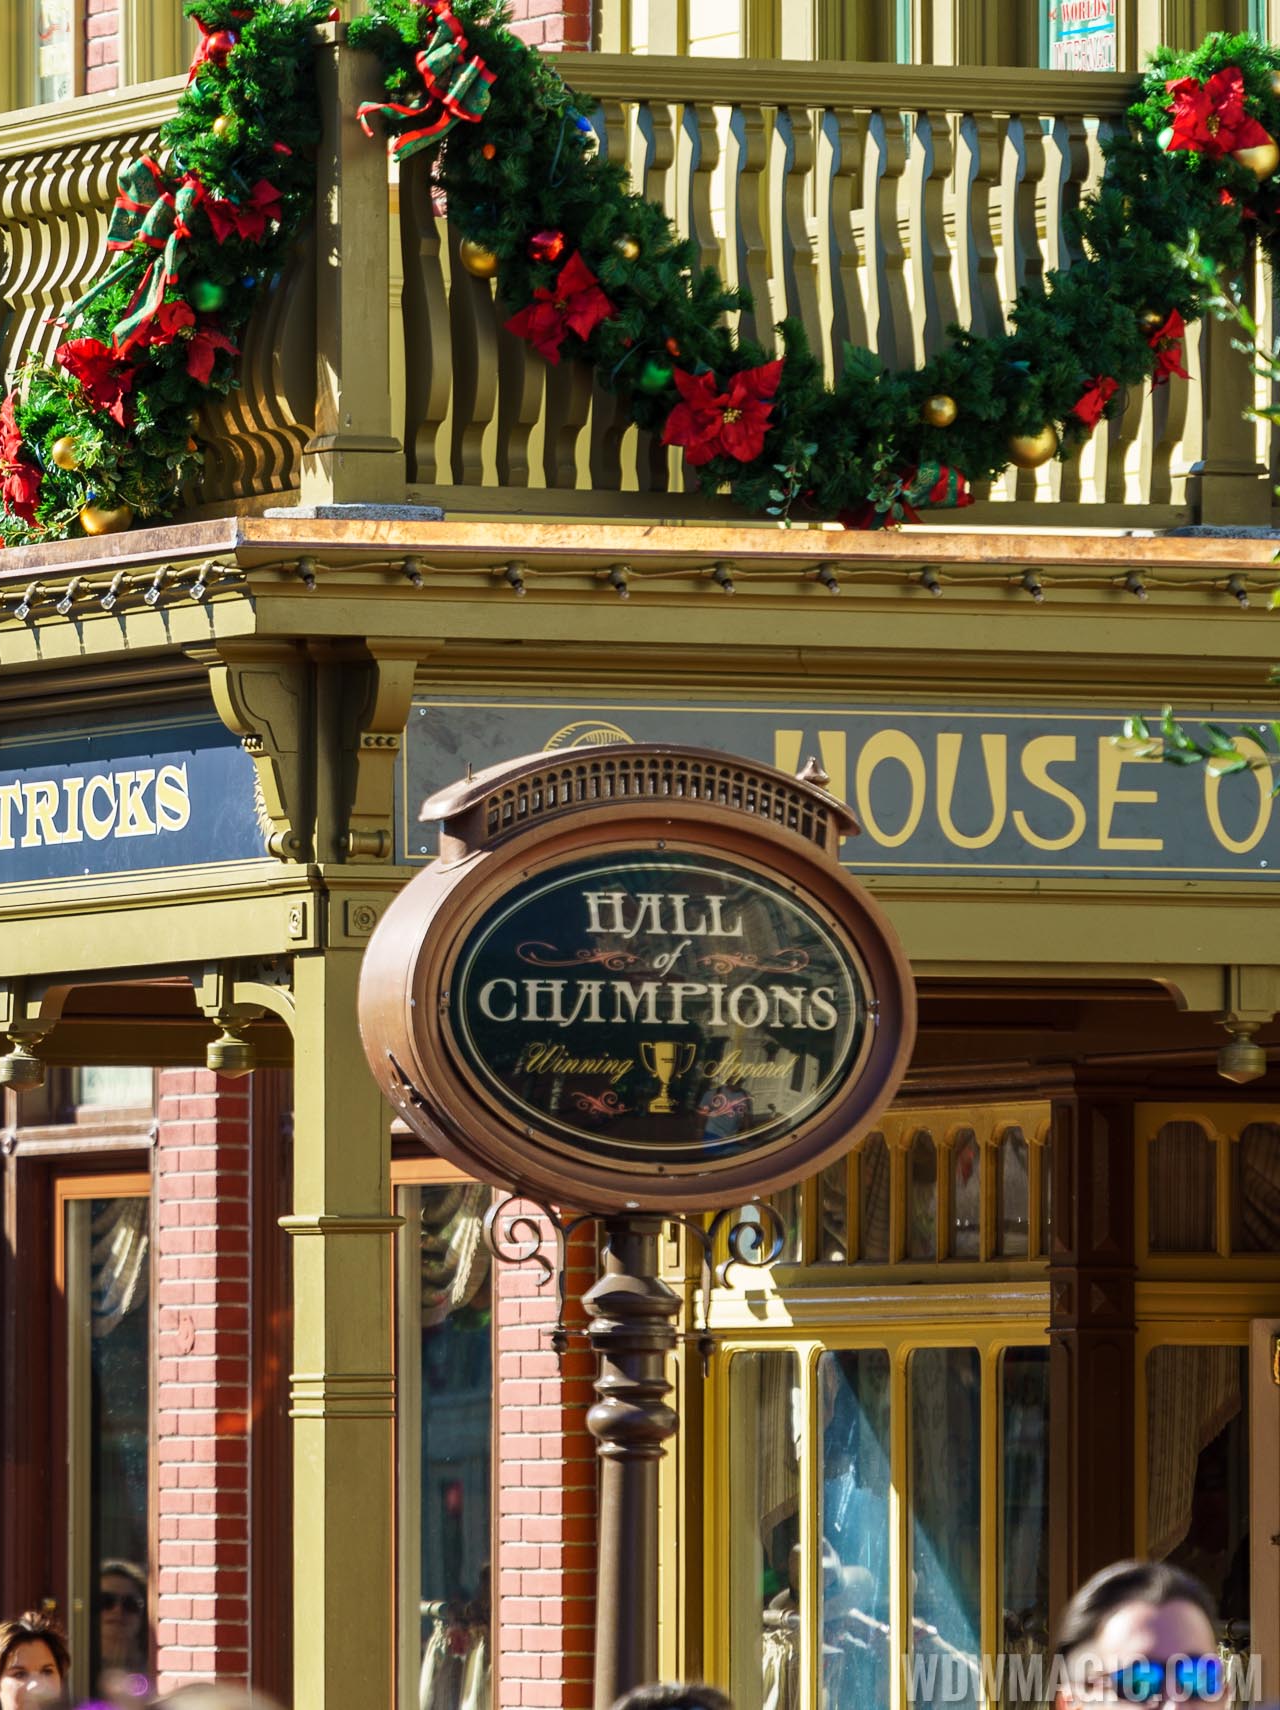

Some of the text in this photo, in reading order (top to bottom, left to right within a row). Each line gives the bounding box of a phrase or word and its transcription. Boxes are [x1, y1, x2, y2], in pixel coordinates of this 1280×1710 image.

[582, 890, 743, 939] HALL
[652, 940, 692, 977] of
[479, 978, 838, 1031] CHAMPIONS
[524, 1040, 799, 1085] Winning Apparel
